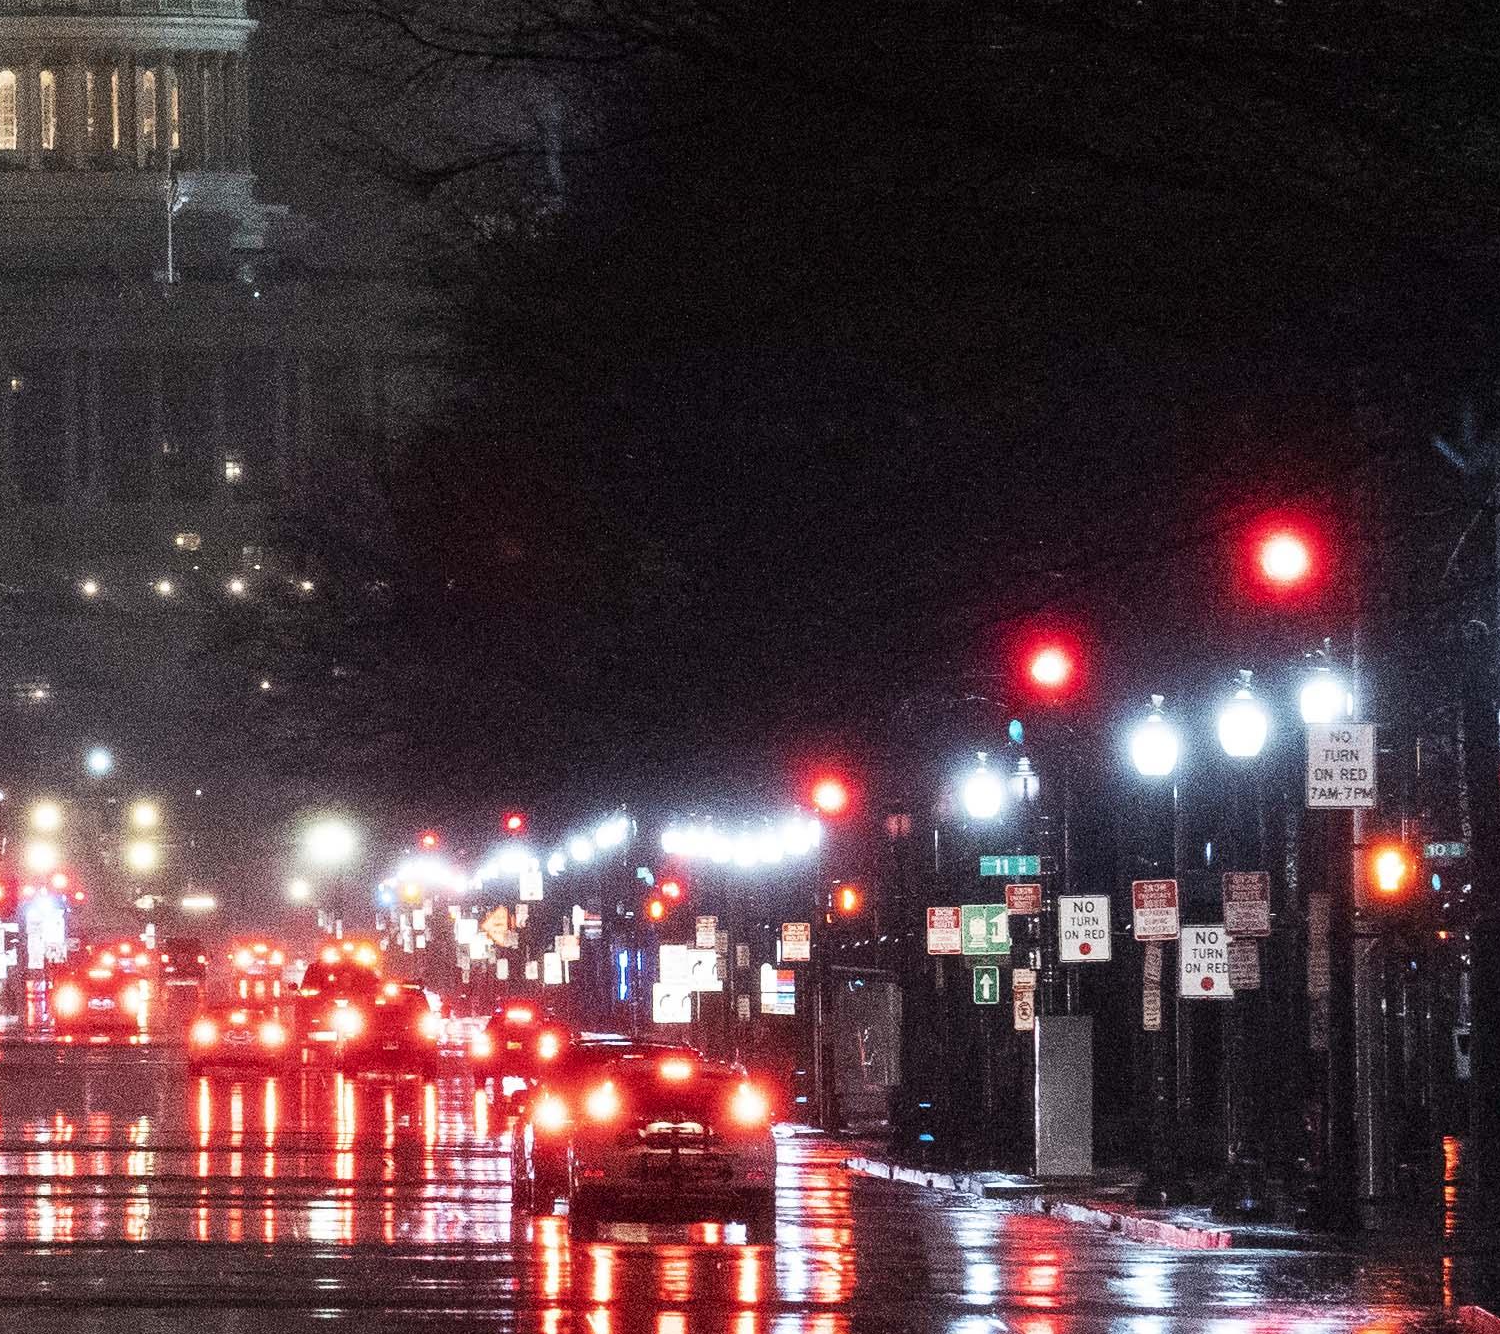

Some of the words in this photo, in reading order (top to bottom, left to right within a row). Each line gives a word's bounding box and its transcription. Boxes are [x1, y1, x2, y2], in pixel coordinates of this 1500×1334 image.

[1329, 730, 1353, 744] NO
[1322, 748, 1359, 763] TURN
[1314, 768, 1333, 781] ON
[1340, 768, 1368, 781] RED
[1311, 786, 1375, 800] 7AM-7PM
[1073, 901, 1095, 913] NO
[1070, 916, 1099, 927] TURN
[1064, 929, 1079, 940] ON
[1084, 929, 1105, 940] RED
[1195, 931, 1219, 944] NO
[1192, 948, 1223, 959] TURN
[1185, 963, 1201, 973] ON
[1207, 962, 1229, 973] RED
